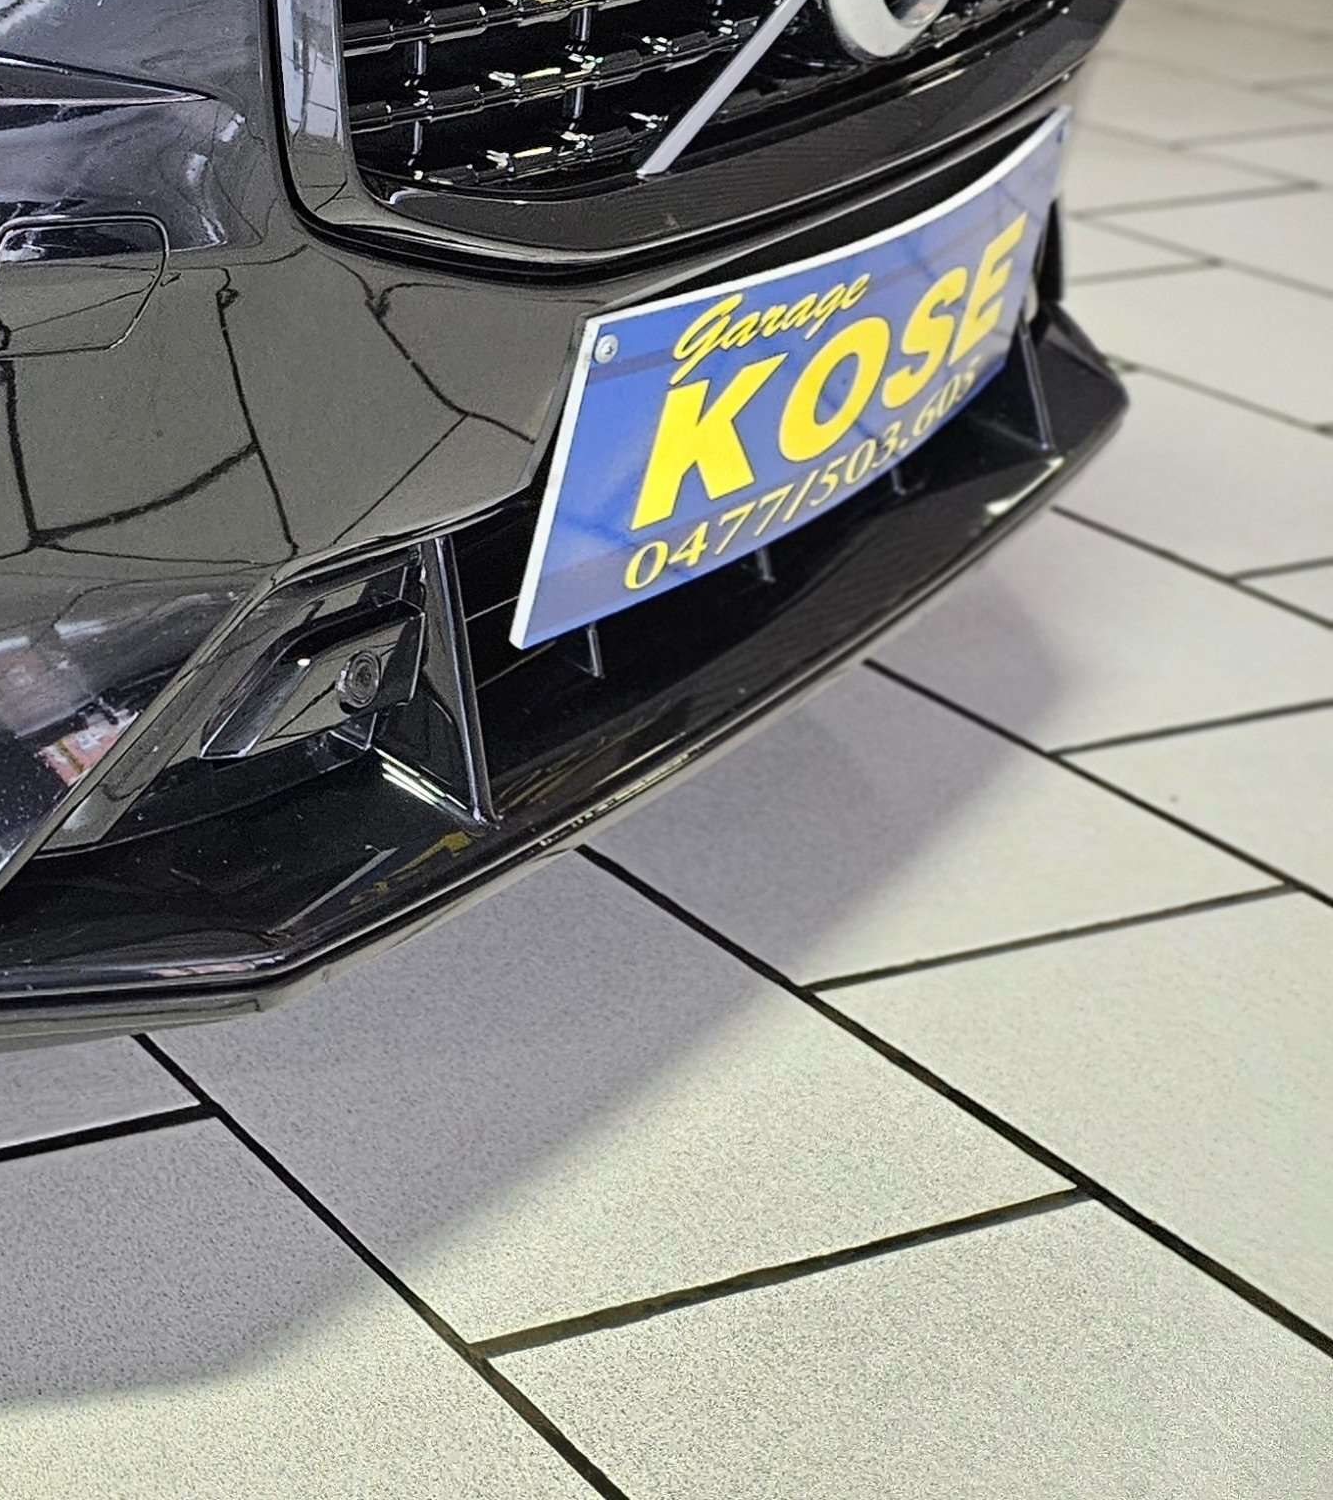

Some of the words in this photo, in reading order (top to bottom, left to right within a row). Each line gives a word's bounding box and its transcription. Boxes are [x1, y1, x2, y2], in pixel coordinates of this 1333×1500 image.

[632, 212, 1027, 531] KOSE
[670, 273, 869, 385] Garage
[623, 356, 980, 590] 0477/503.605
